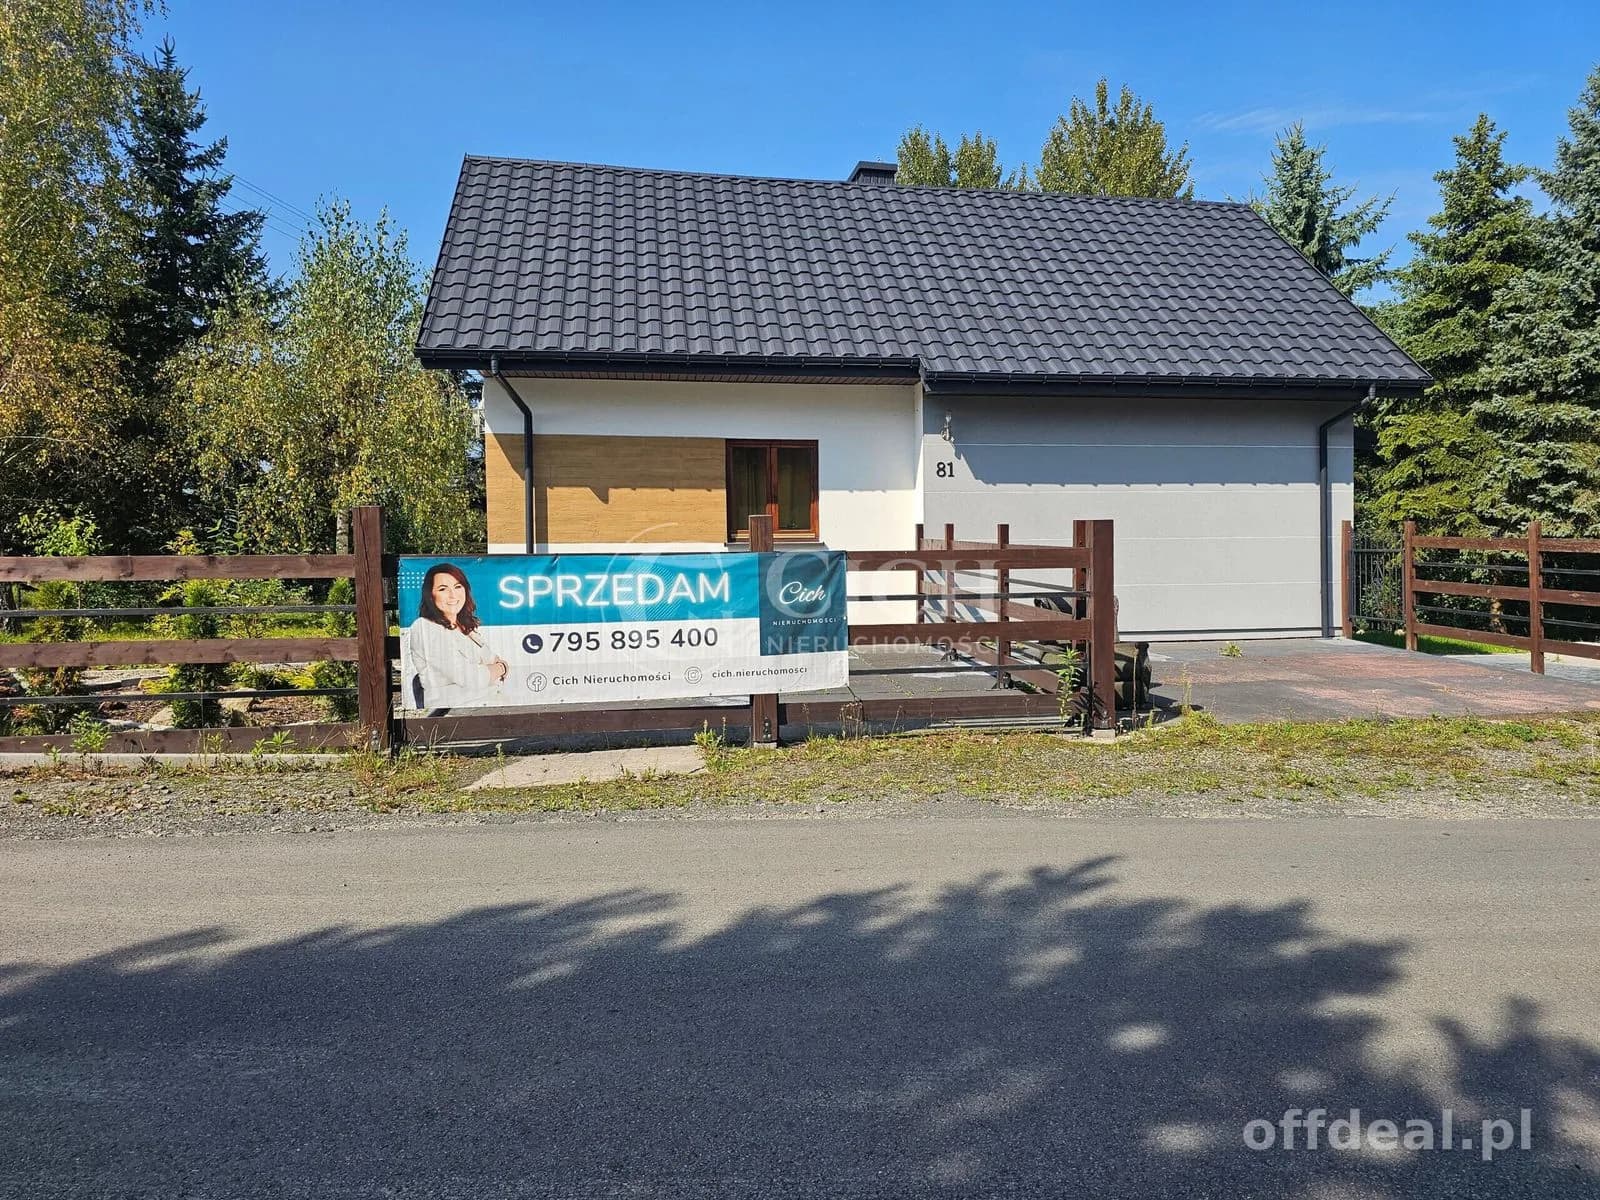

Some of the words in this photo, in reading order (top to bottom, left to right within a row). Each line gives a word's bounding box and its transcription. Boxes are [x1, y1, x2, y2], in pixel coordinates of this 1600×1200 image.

[936, 461, 955, 478] 81
[497, 573, 730, 609] SPRZEDAM
[779, 581, 826, 605] Cich
[550, 631, 600, 652] 795
[611, 628, 660, 650] 895
[670, 626, 718, 648] 400
[552, 675, 579, 686] Cich
[583, 671, 671, 685] Nieruchomości
